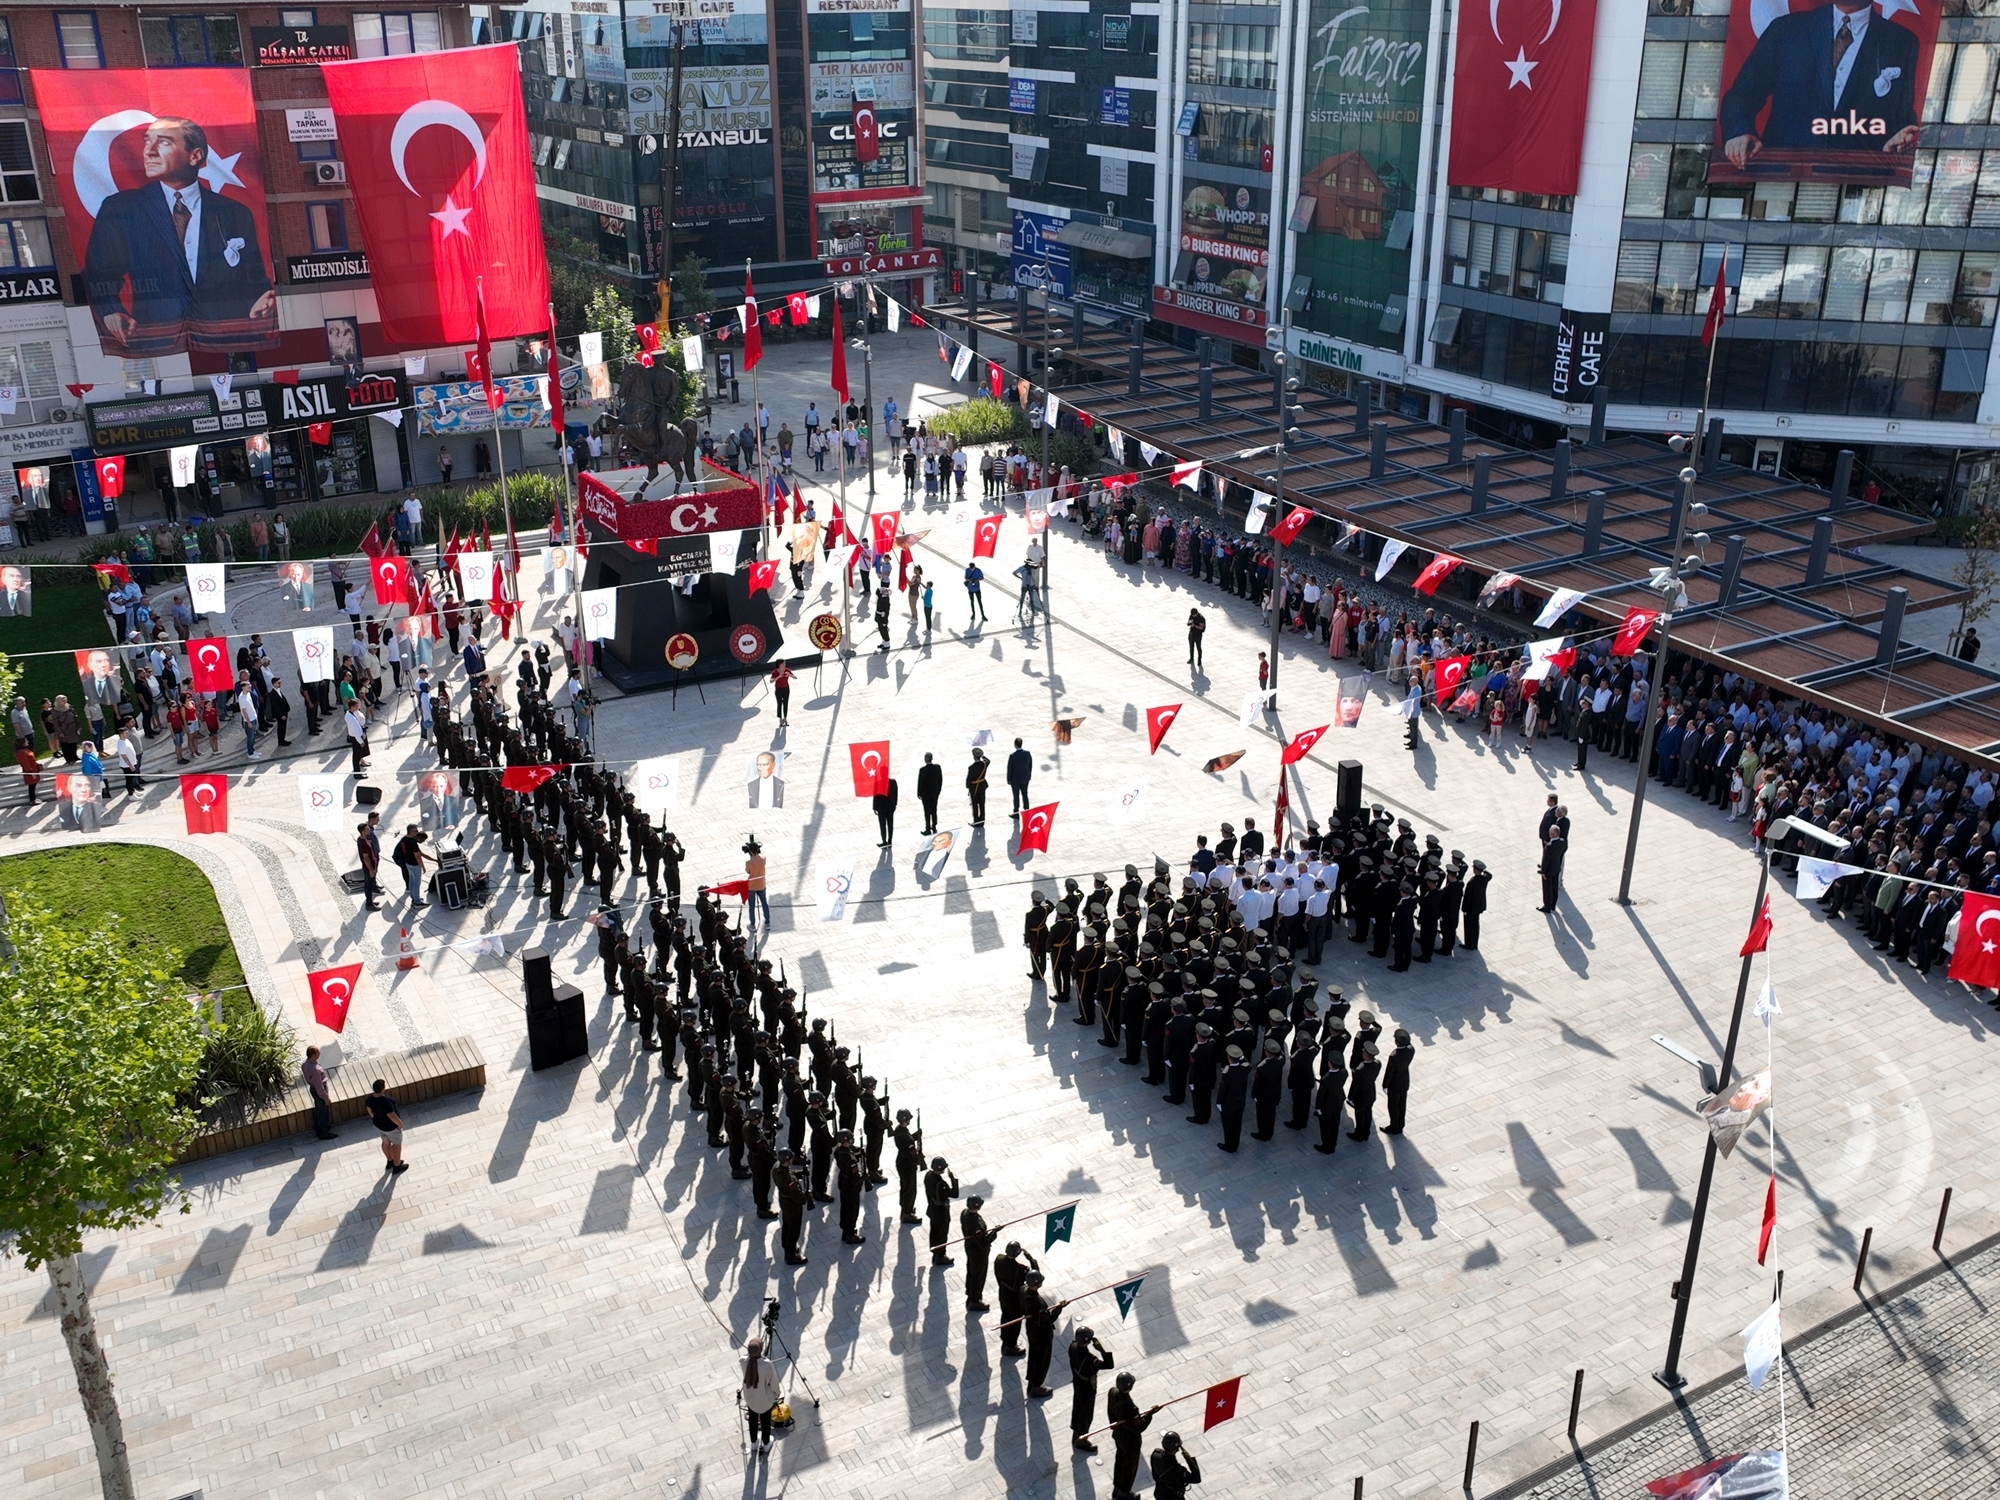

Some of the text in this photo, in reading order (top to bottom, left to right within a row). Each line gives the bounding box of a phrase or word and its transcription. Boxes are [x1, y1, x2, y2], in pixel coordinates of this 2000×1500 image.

[818, 0, 899, 11] RESTAURANT
[818, 62, 905, 75] TIR / KAMYON
[654, 81, 771, 109] YAVUZ
[1340, 92, 1390, 105] EV ALMA
[296, 119, 327, 128] TAPANCI
[634, 110, 770, 134] SÜRCÜ KURSU
[1310, 107, 1420, 123] SİSTEMİNİN MUCİDİ
[311, 126, 334, 135] BÜROSU
[829, 122, 898, 141] CLIC
[605, 202, 624, 217] KEBAP
[1191, 238, 1259, 264] BURGER KING
[291, 255, 370, 280] MÜHENDİSLİ
[827, 252, 938, 274] LOKANTA
[1176, 292, 1240, 320] BURGER KING
[1299, 339, 1363, 372] EMİNEVİM
[1552, 321, 1574, 394] ÇERKEZ
[1578, 331, 1604, 386] CAFE
[282, 383, 337, 420] ASİL
[12, 441, 23, 453] İŞ
[24, 436, 64, 450] MERKEZİ
[95, 425, 187, 446] CMR İLETİŞİM
[81, 461, 96, 504] SEVER
[657, 559, 697, 573] KAYITSIZ
